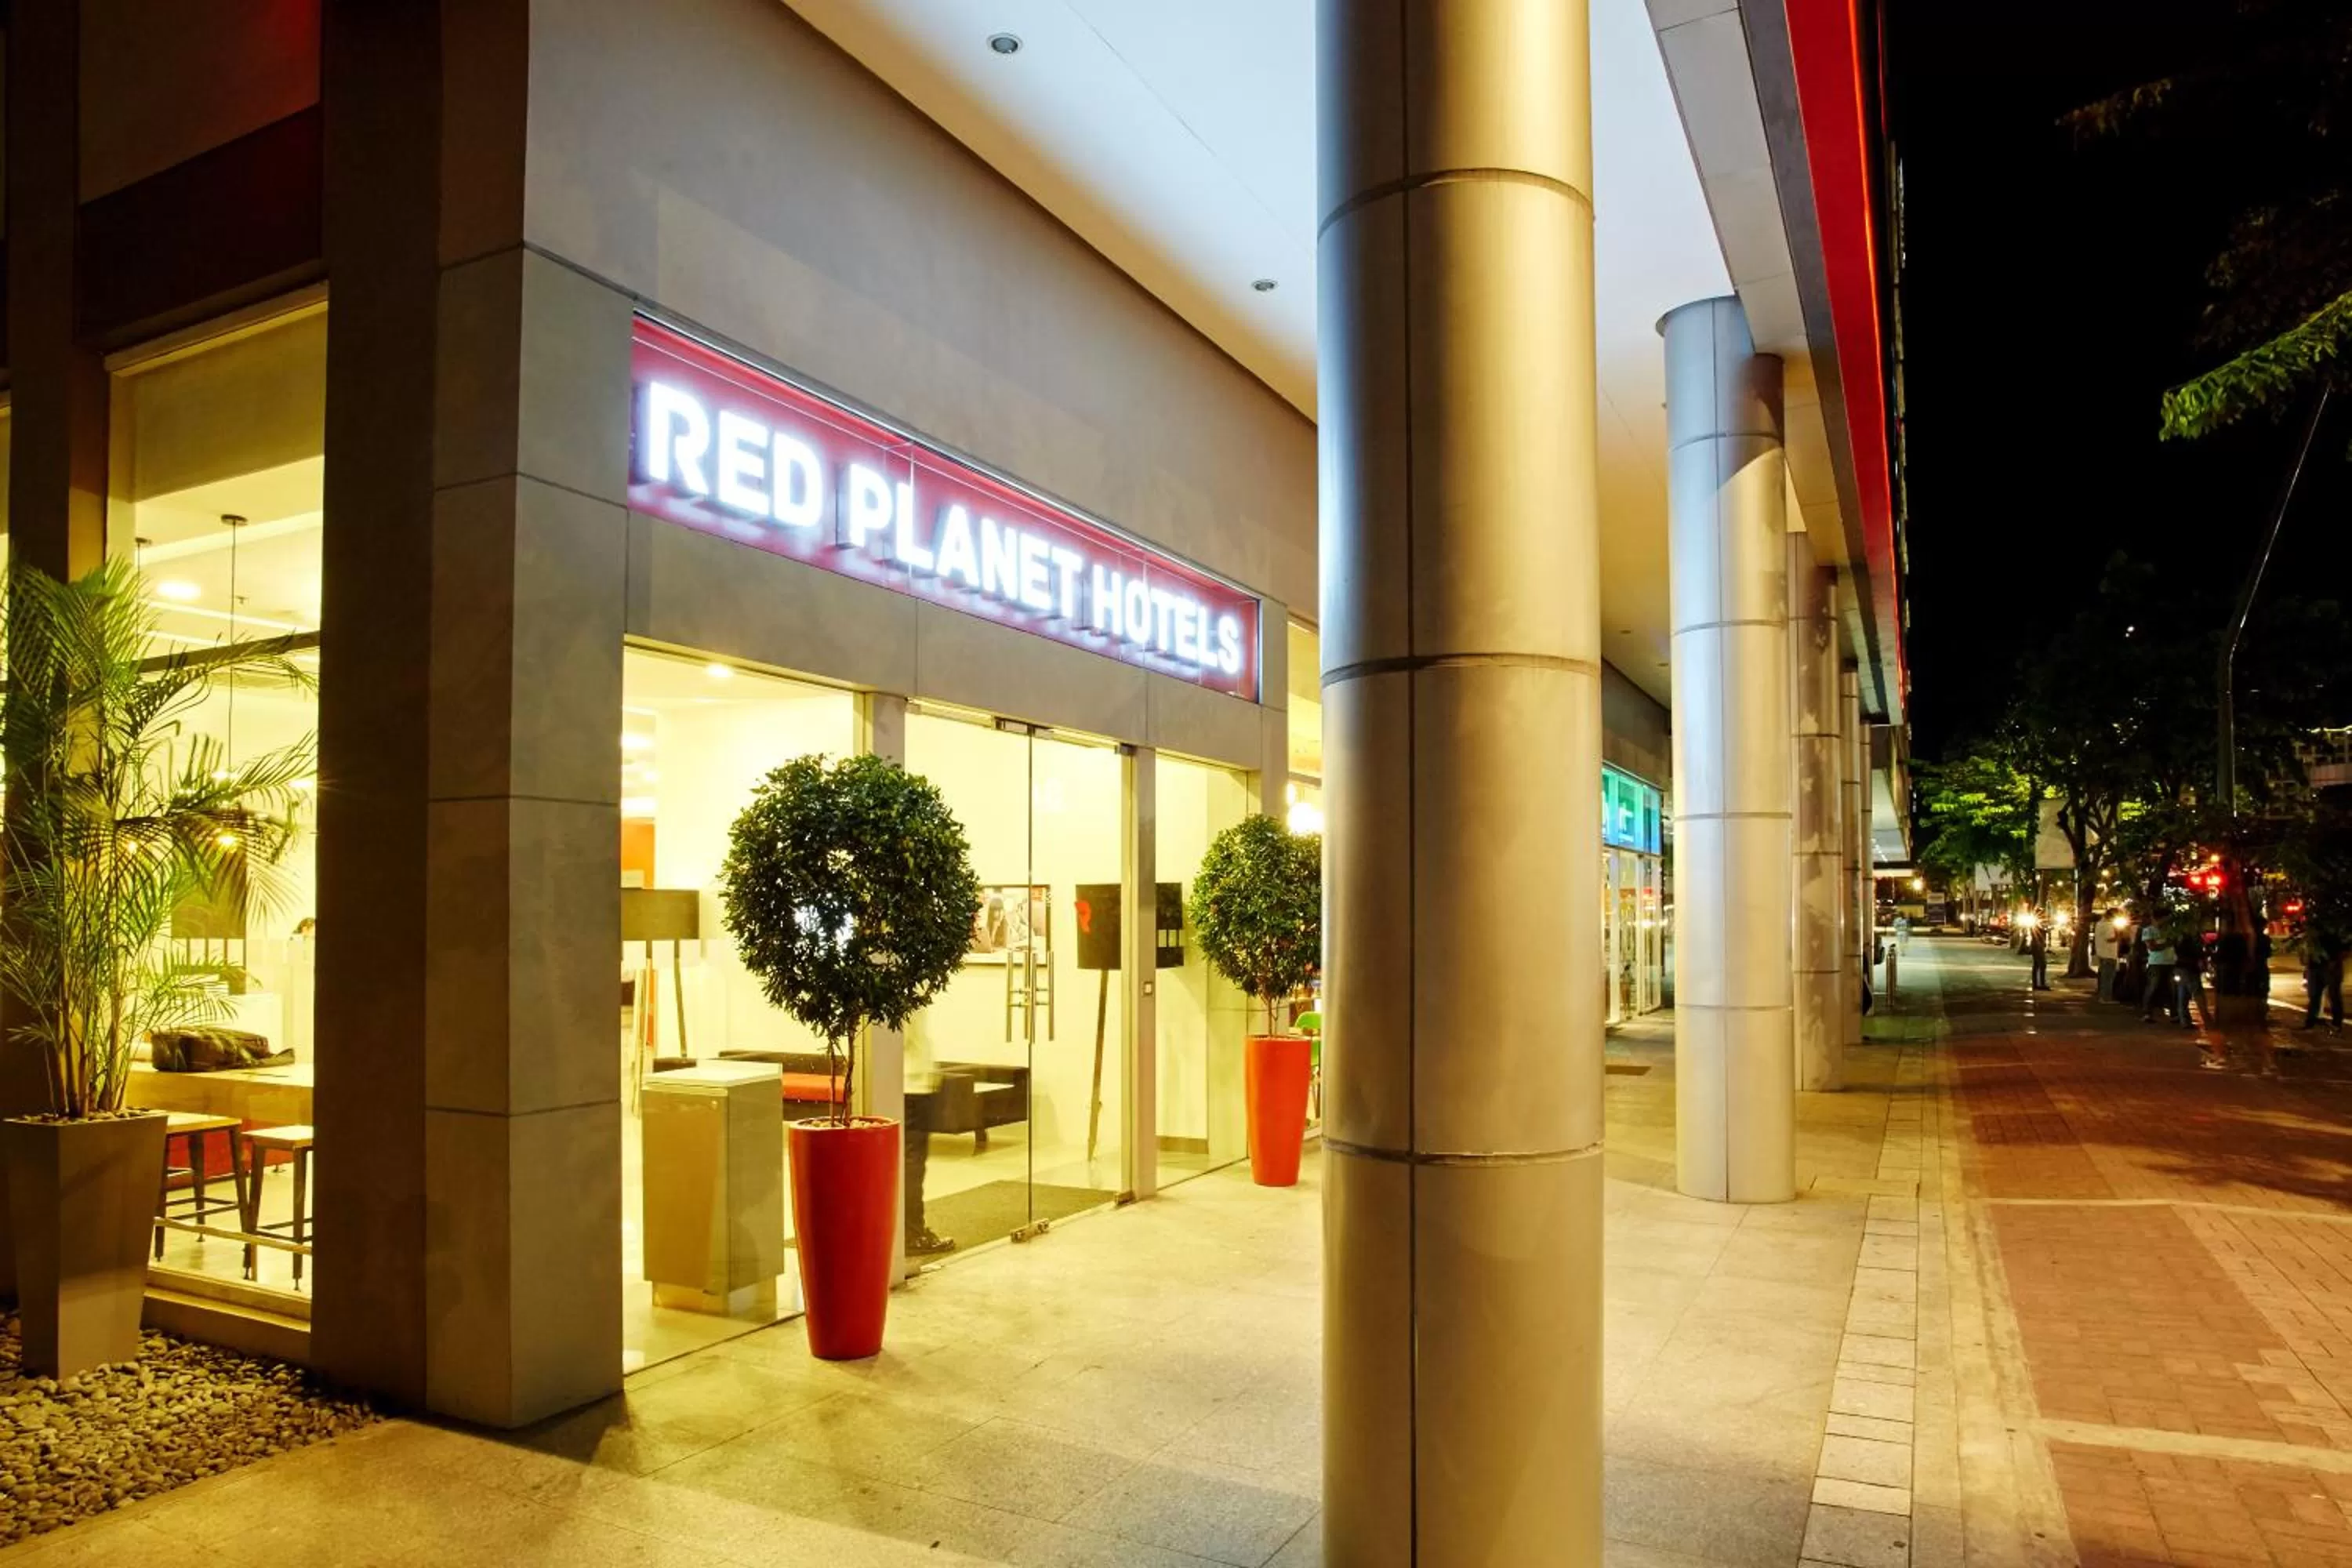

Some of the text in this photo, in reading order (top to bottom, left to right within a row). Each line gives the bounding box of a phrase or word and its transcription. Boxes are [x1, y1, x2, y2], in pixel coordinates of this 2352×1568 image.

[648, 380, 1241, 675] RED PLANET HOTELS
